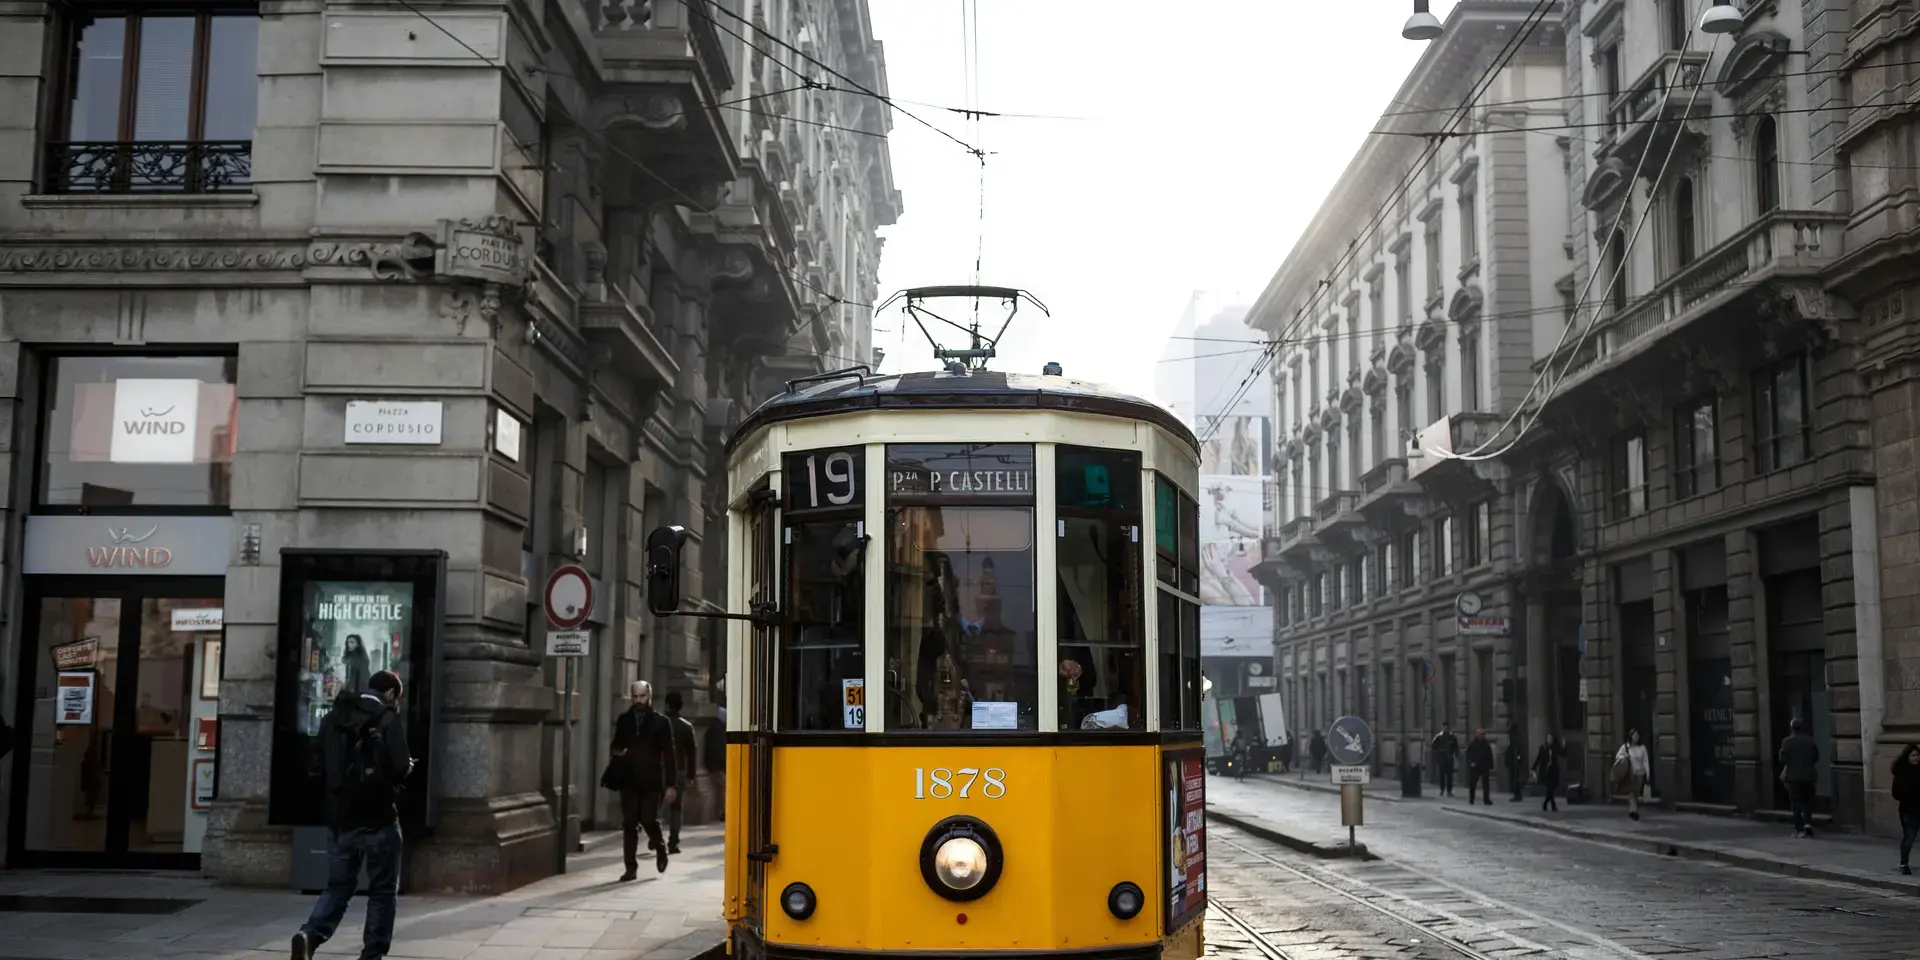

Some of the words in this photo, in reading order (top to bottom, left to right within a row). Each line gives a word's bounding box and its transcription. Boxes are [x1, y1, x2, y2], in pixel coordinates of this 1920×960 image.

[378, 408, 409, 416] PIAZZA
[123, 420, 186, 435] WIND
[353, 423, 434, 435] CORDUSIO
[806, 451, 856, 508] 19
[950, 470, 1029, 491] CASTELLI
[87, 546, 172, 568] WIND
[318, 603, 352, 620] HIGH
[355, 603, 403, 620] CASTLE
[847, 688, 862, 705] 51
[848, 707, 863, 725] 19
[914, 767, 1007, 800] 1878
